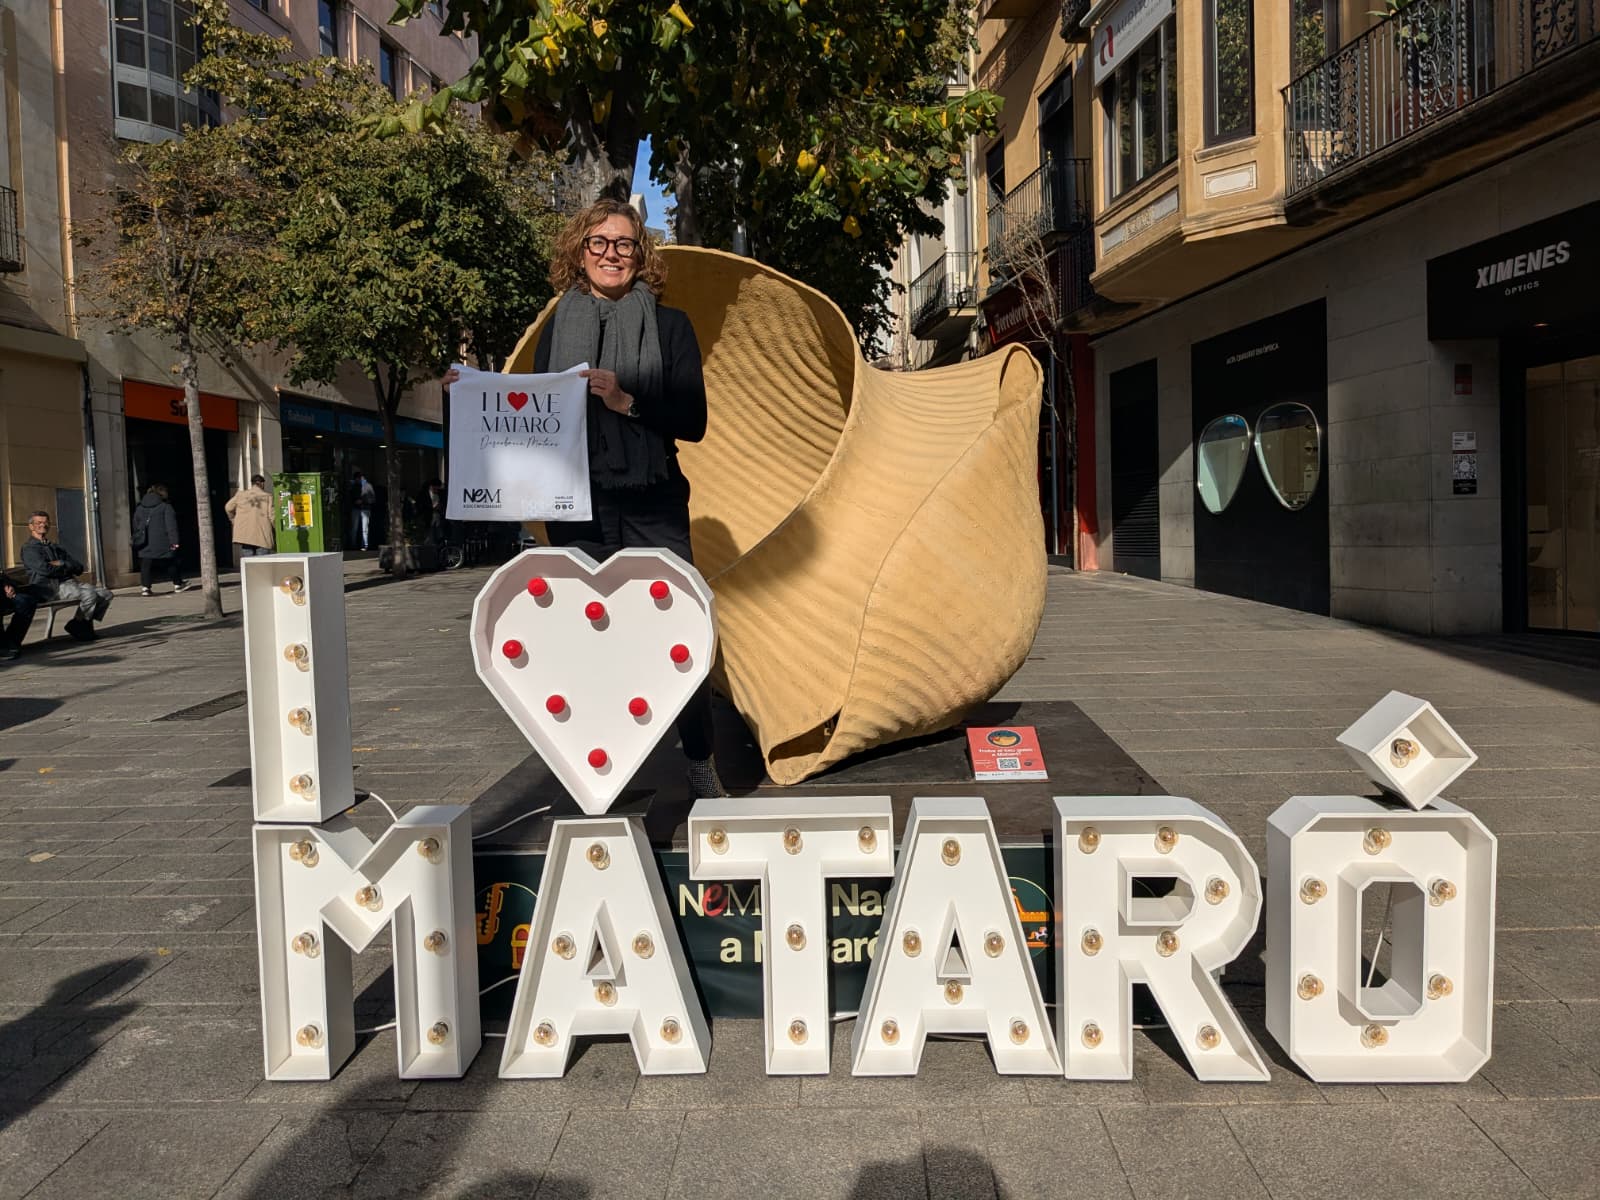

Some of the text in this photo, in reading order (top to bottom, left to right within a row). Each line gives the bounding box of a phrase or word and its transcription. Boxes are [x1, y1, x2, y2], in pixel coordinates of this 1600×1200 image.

[1476, 241, 1570, 288] XIMENES
[482, 392, 487, 411] I
[481, 414, 561, 433] MATARÓ
[241, 551, 355, 823] I
[252, 690, 1498, 1083] MATARÓ
[720, 937, 742, 963] a
